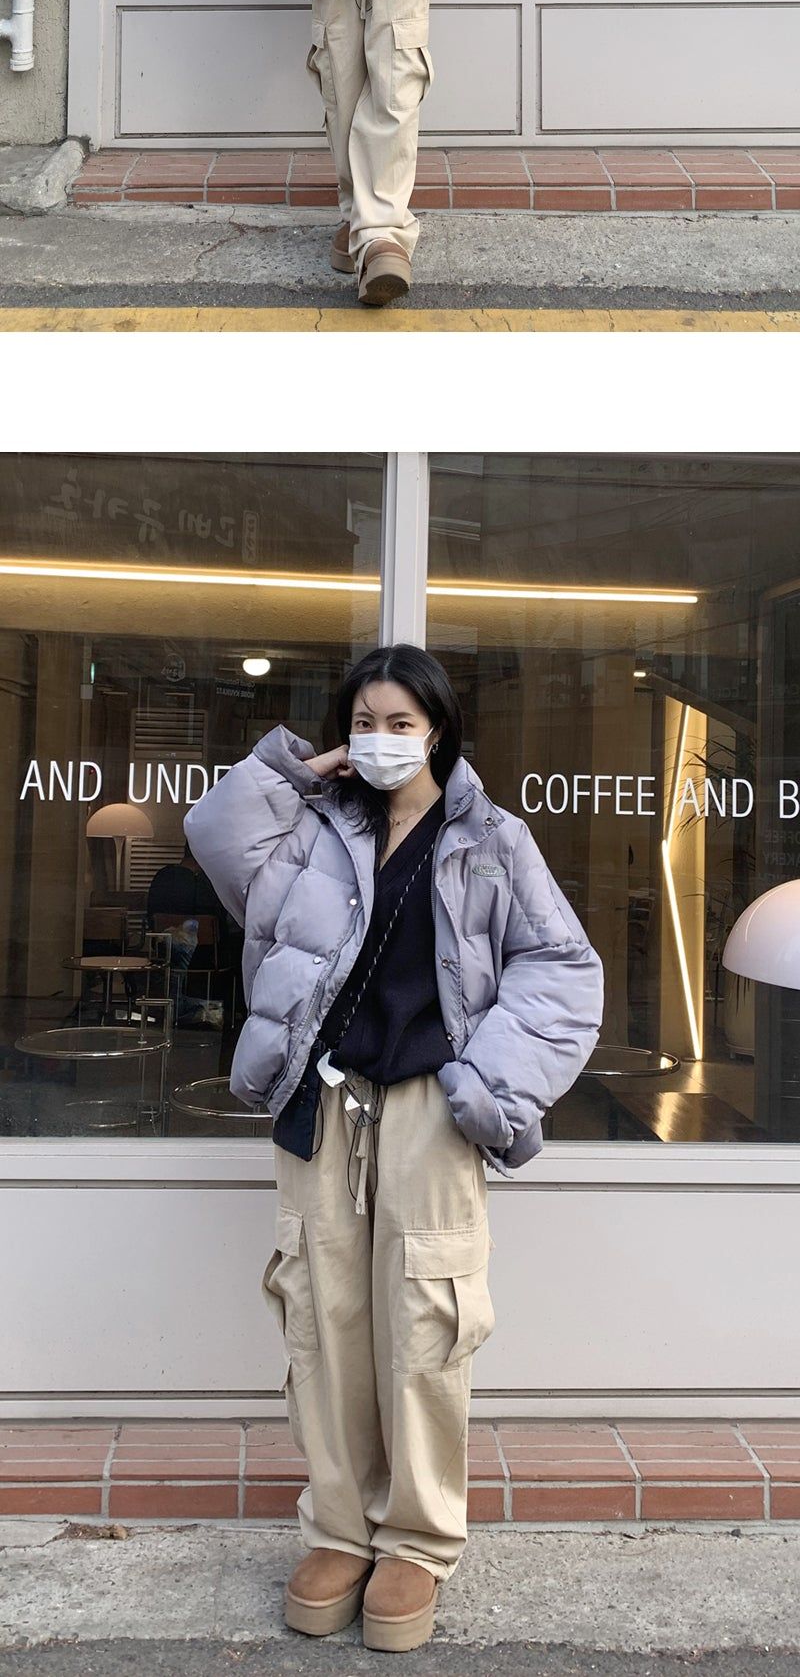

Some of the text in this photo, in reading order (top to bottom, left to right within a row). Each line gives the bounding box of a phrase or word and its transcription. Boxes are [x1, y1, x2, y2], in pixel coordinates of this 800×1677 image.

[19, 759, 102, 802] AND
[521, 773, 656, 816] COFFEE
[678, 777, 754, 818] AND
